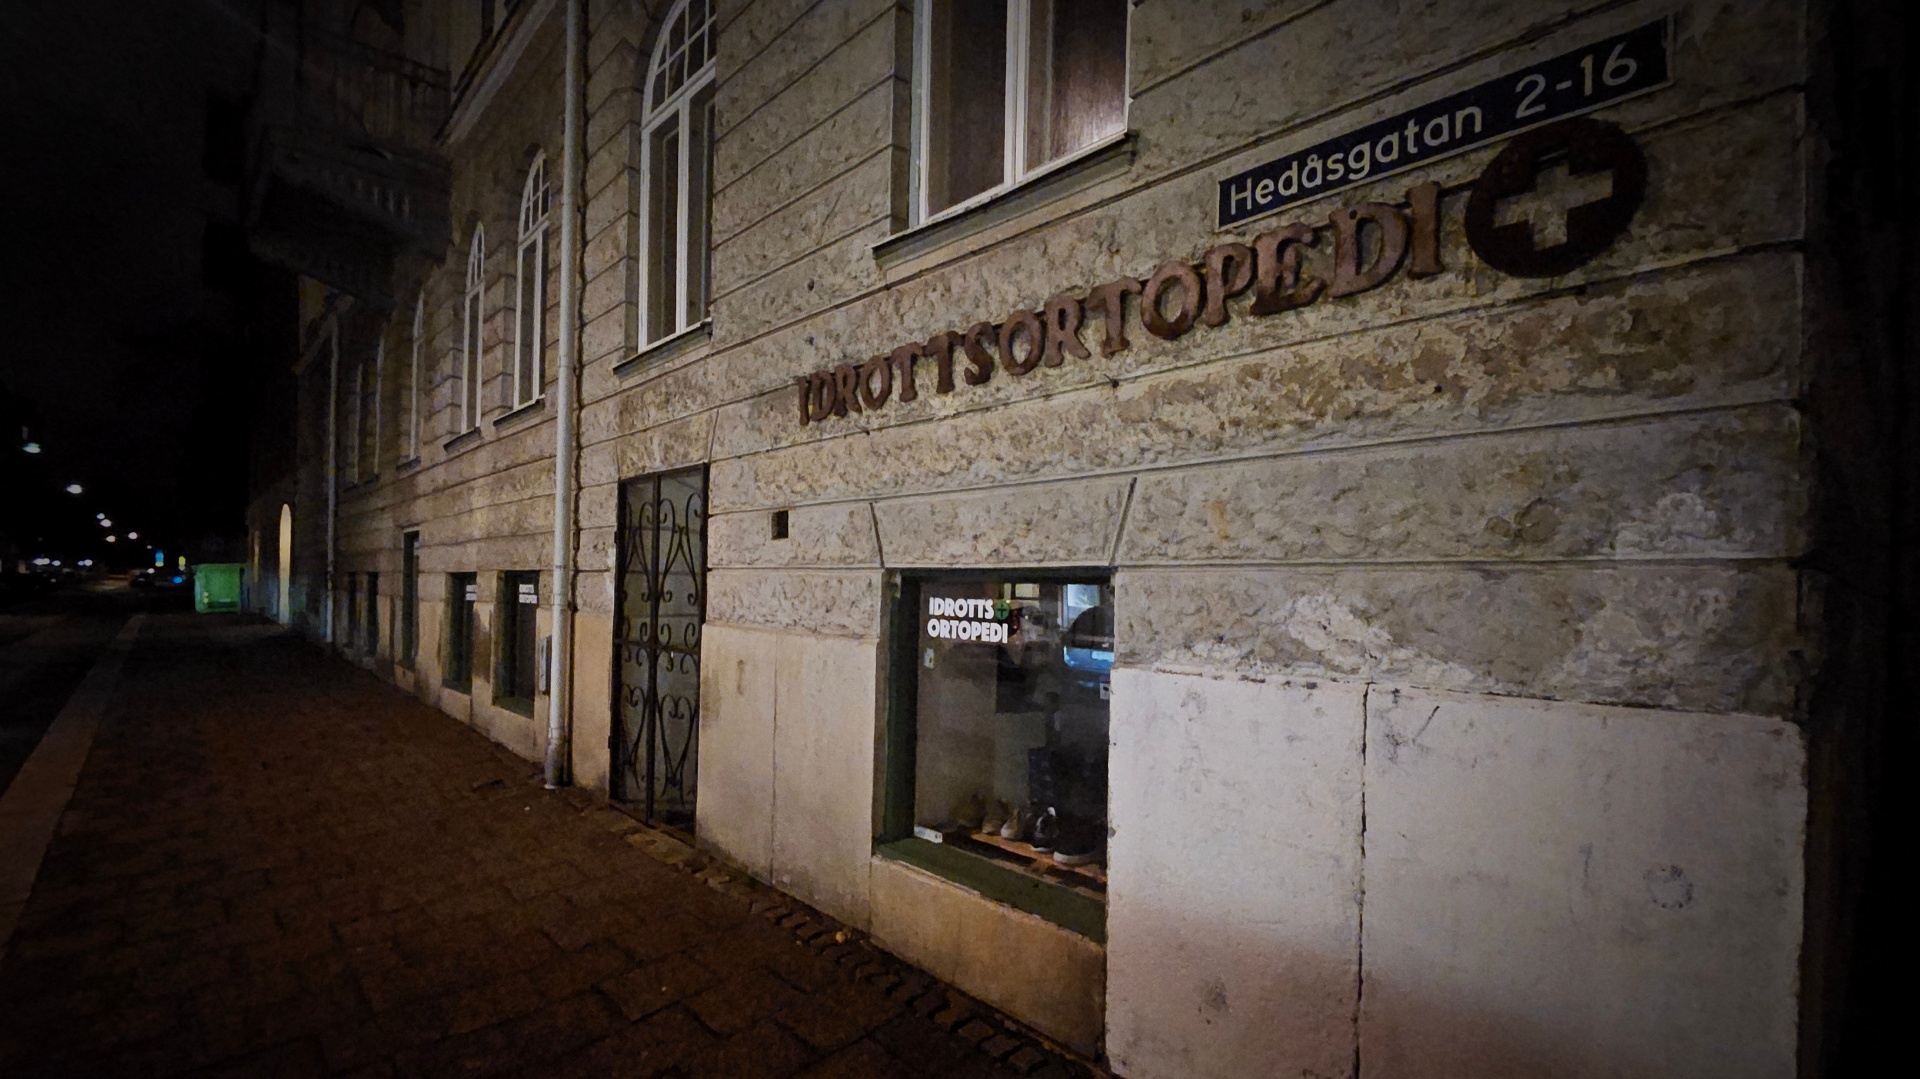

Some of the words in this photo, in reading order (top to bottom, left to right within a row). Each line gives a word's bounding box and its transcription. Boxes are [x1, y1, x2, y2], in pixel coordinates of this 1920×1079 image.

[1230, 104, 1483, 215] Hedåsgatan
[1514, 41, 1639, 120] 2-16
[796, 181, 1446, 426] IDROTTSORTOPEDI
[927, 619, 1009, 644] ORTOPEDI
[928, 597, 995, 619] IDROTTS
